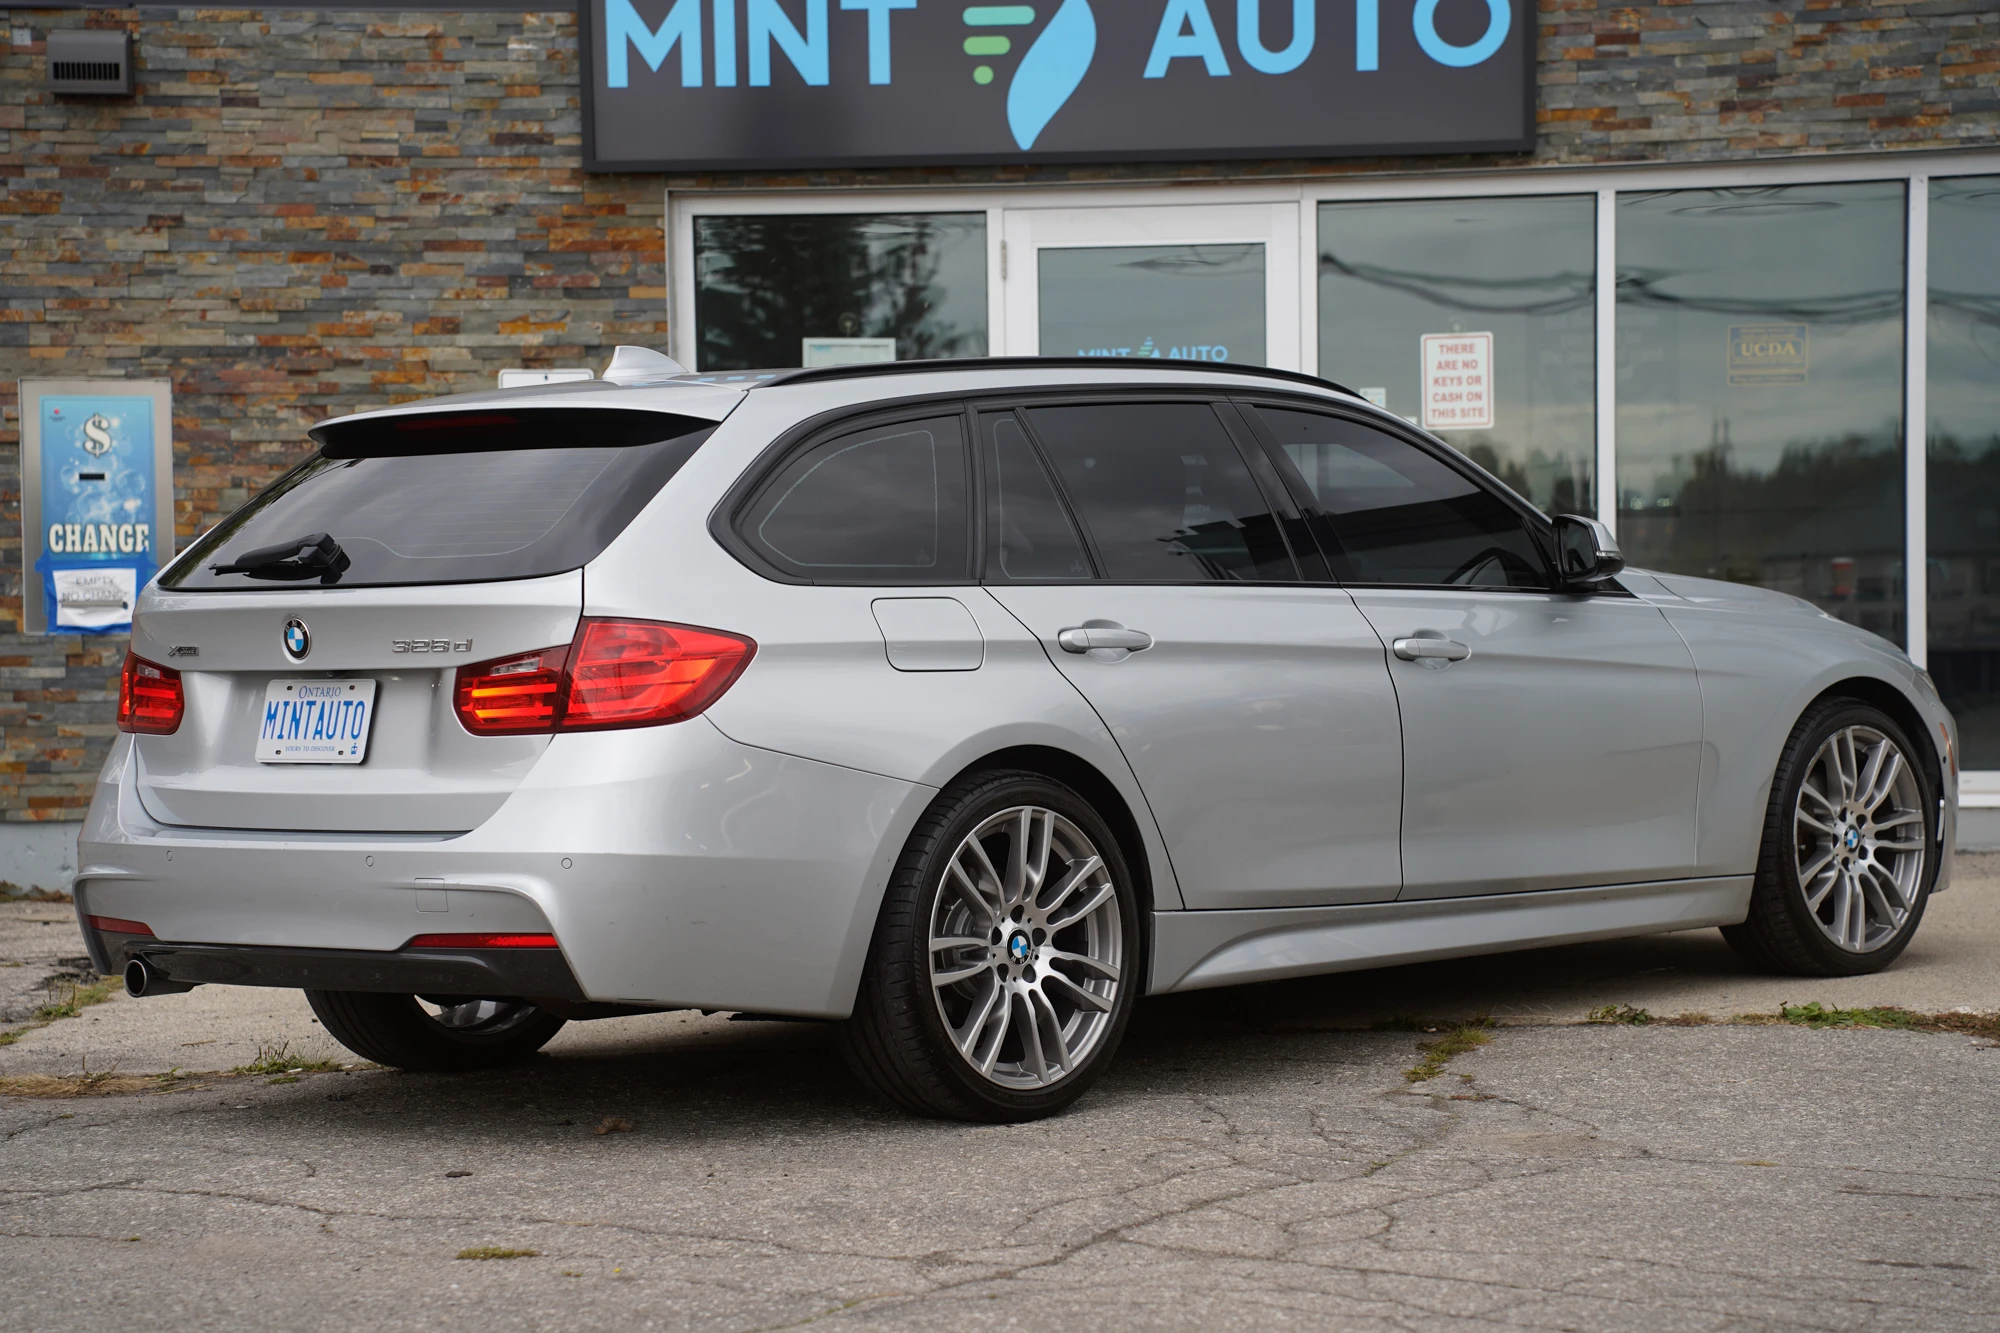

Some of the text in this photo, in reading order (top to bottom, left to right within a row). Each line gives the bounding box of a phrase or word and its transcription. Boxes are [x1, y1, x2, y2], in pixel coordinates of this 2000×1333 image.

[605, 0, 1511, 88] MINT AUTO
[1169, 345, 1228, 362] AUTO
[1438, 343, 1476, 355] THERE
[1741, 341, 1796, 356] UCDA
[1436, 359, 1479, 371] ARE NO
[1433, 375, 1482, 387] KEYS OR
[1432, 391, 1482, 403] CASH ON
[1431, 407, 1484, 419] THIS SITE
[83, 412, 112, 458] $
[48, 523, 149, 553] CHANGE
[76, 576, 115, 586] EMPTY
[62, 592, 79, 603] NO
[392, 638, 473, 653] 328d
[262, 700, 366, 740] MINTAUTO
